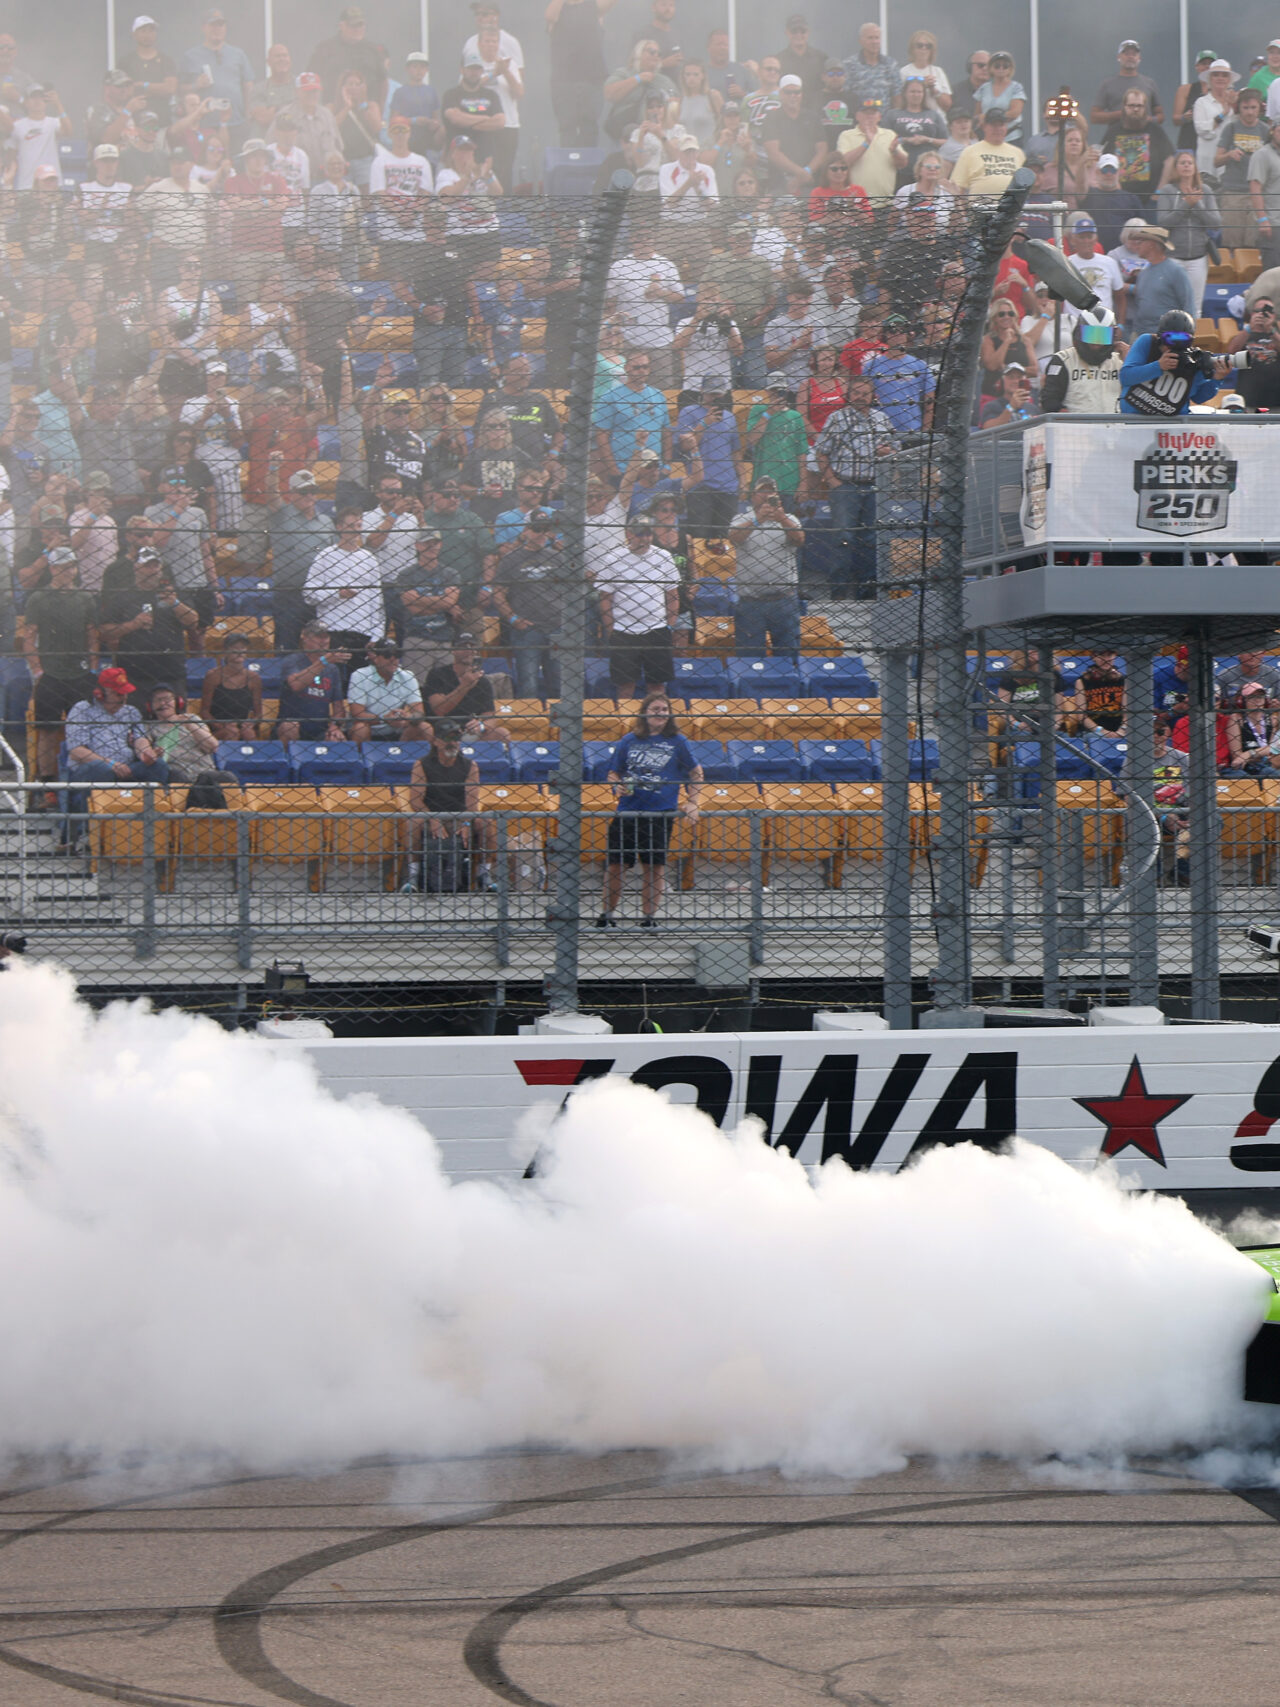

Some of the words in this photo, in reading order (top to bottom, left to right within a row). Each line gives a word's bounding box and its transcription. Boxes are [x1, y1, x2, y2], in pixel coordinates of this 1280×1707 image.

[1071, 369, 1119, 381] OFFICIA
[1157, 432, 1216, 452] HyVee
[1141, 465, 1228, 484] PERKS
[1146, 493, 1220, 519] 250
